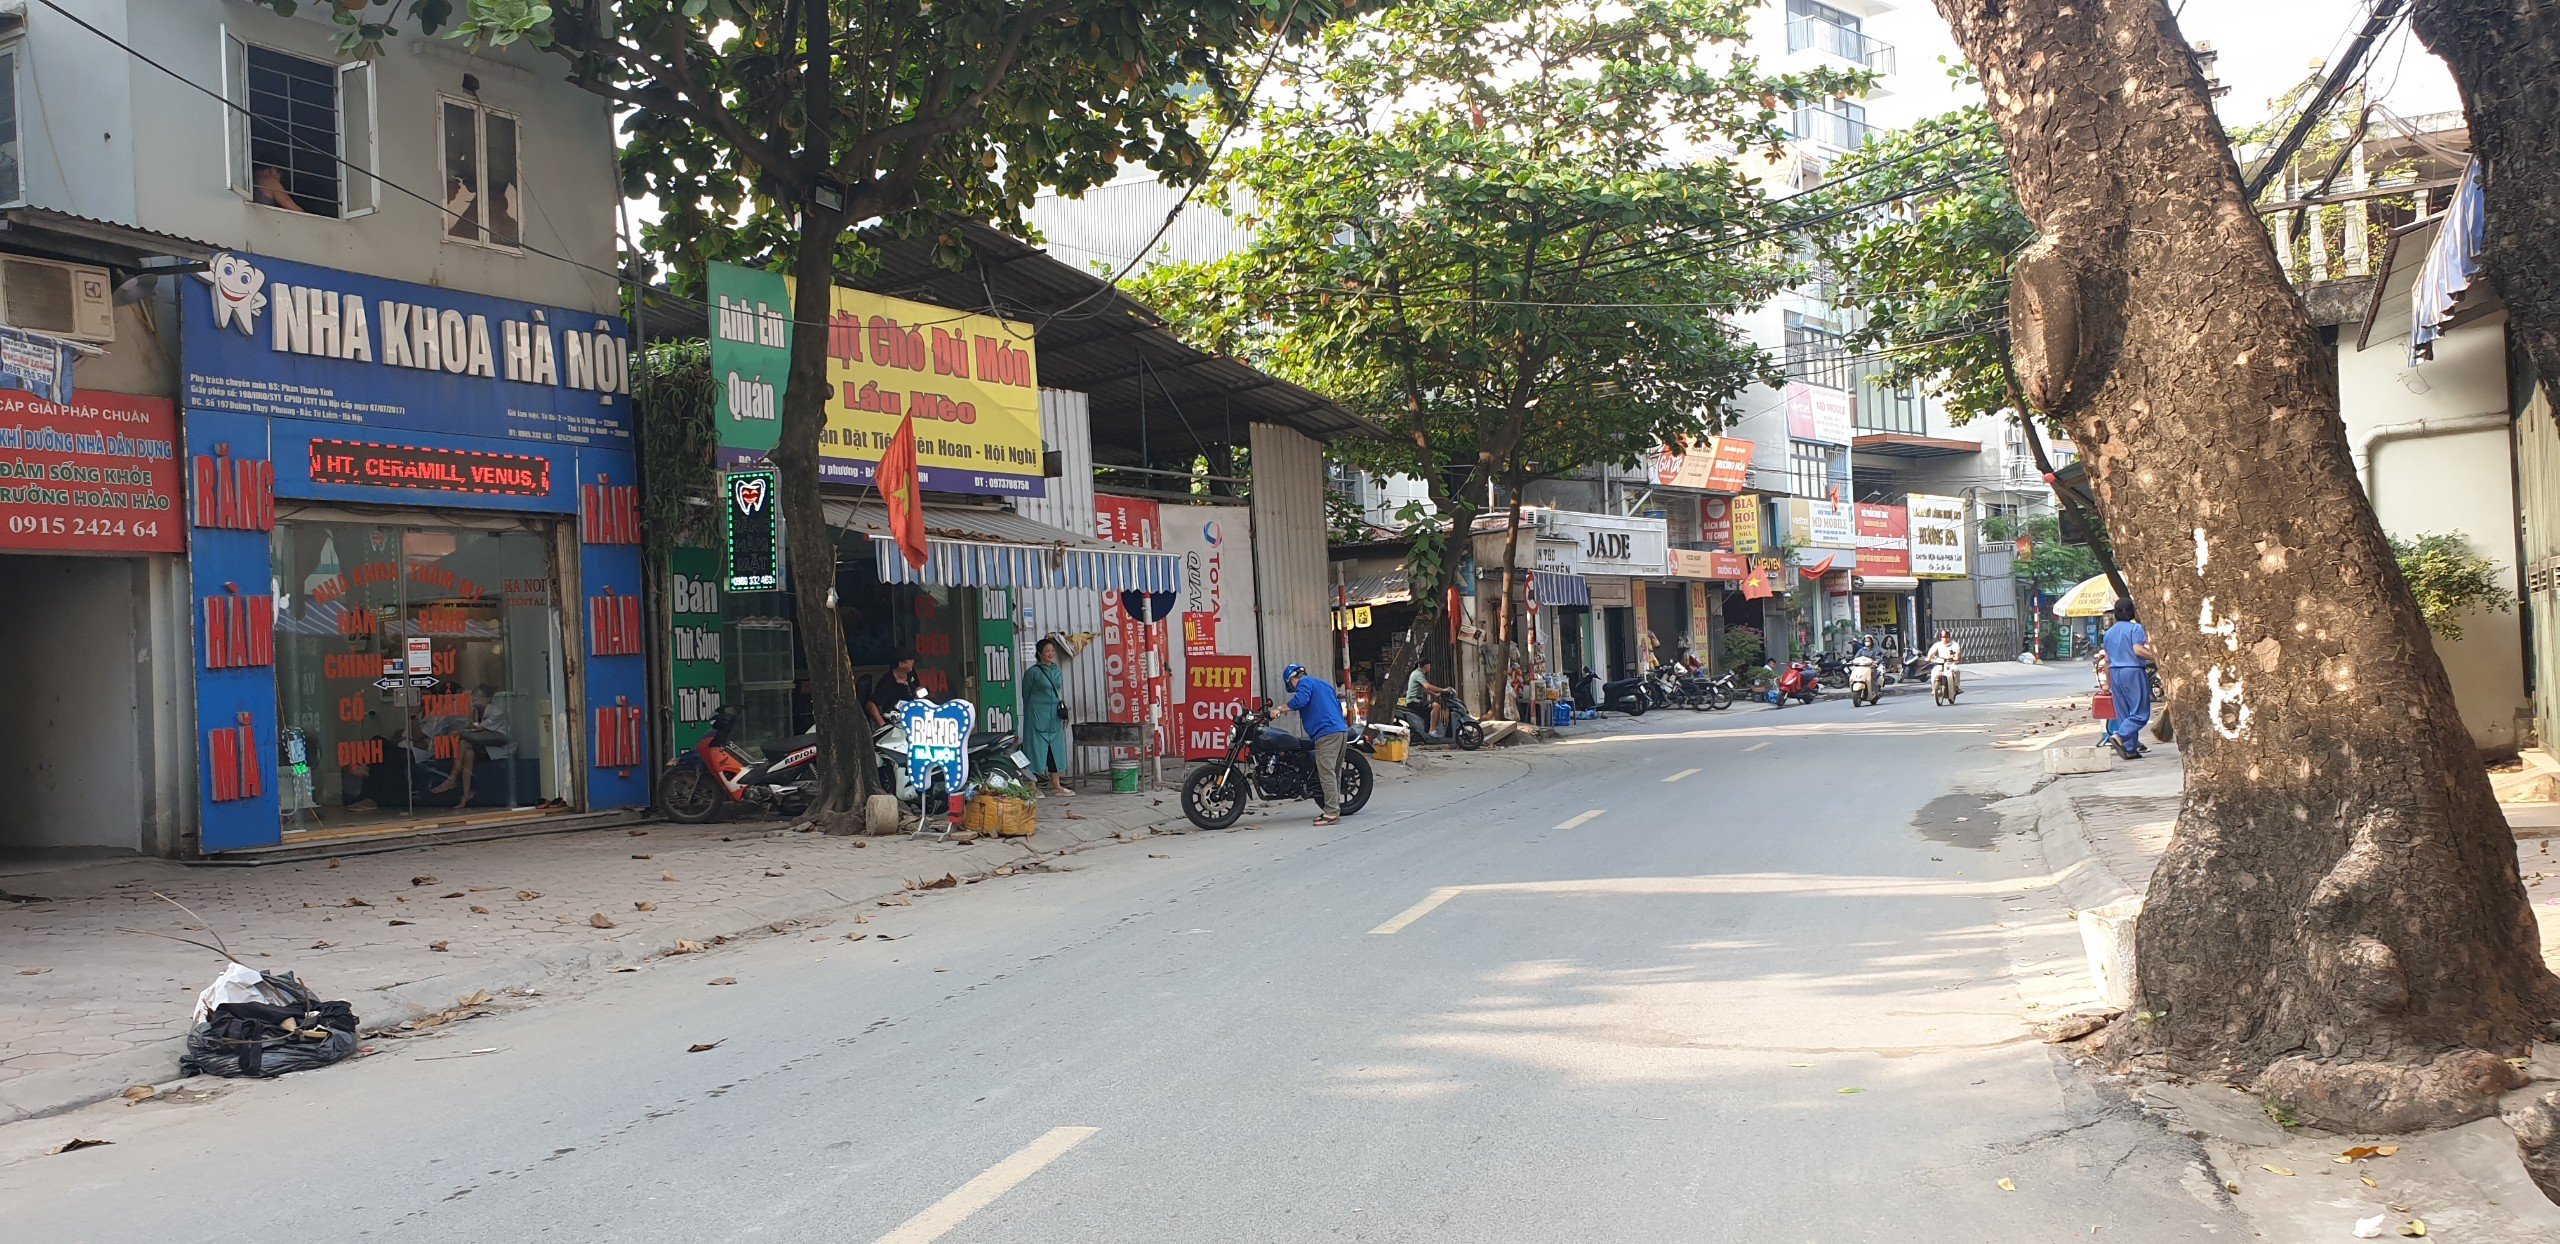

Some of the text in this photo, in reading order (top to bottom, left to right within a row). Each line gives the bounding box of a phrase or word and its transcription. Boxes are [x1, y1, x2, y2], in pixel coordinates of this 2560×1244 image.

[719, 295, 785, 349] Anh Em
[270, 282, 630, 406] NHA KHOA HÀ NỘI
[826, 309, 1032, 388] ịt Chó Đủ Món
[61, 404, 99, 419] PHÁP
[728, 371, 775, 421] Quán
[843, 380, 977, 425] Lẩu Mèo
[0, 424, 173, 464] KHÍ DƯỠNG NHÀ DÂN DỤNG
[819, 427, 838, 447] ận
[842, 428, 868, 451] Đặt
[913, 436, 934, 455] iên
[938, 439, 973, 459] Hoan
[1009, 446, 1038, 468] Nghị
[50, 461, 100, 483] SỐNG
[104, 465, 153, 486] KHỎE
[193, 443, 275, 532] RĂNG
[471, 466, 538, 489] VENUS,
[0, 483, 171, 511] RƯỞNG HOÀN HẢO
[582, 473, 642, 545] RĂNG
[9, 515, 158, 538] 0915 2424 64
[1586, 531, 1631, 559] JADE
[311, 573, 350, 606] NHA
[352, 562, 399, 587] KHOA
[673, 574, 718, 614] Bán
[203, 580, 274, 669] HÀM
[589, 584, 642, 656] HÀM
[324, 645, 383, 678] CHỈNH
[432, 645, 456, 677] SỨ
[675, 622, 721, 666] Thịt Sống
[984, 645, 1011, 688] Thịt
[1105, 654, 1126, 715] ÔTÔ
[1190, 666, 1248, 693] THỊT
[678, 687, 699, 728] Thịt
[911, 709, 961, 747] RĂNG
[1192, 697, 1243, 720] CHÓ
[595, 695, 642, 777] MẶT
[1191, 727, 1231, 750] MÈ
